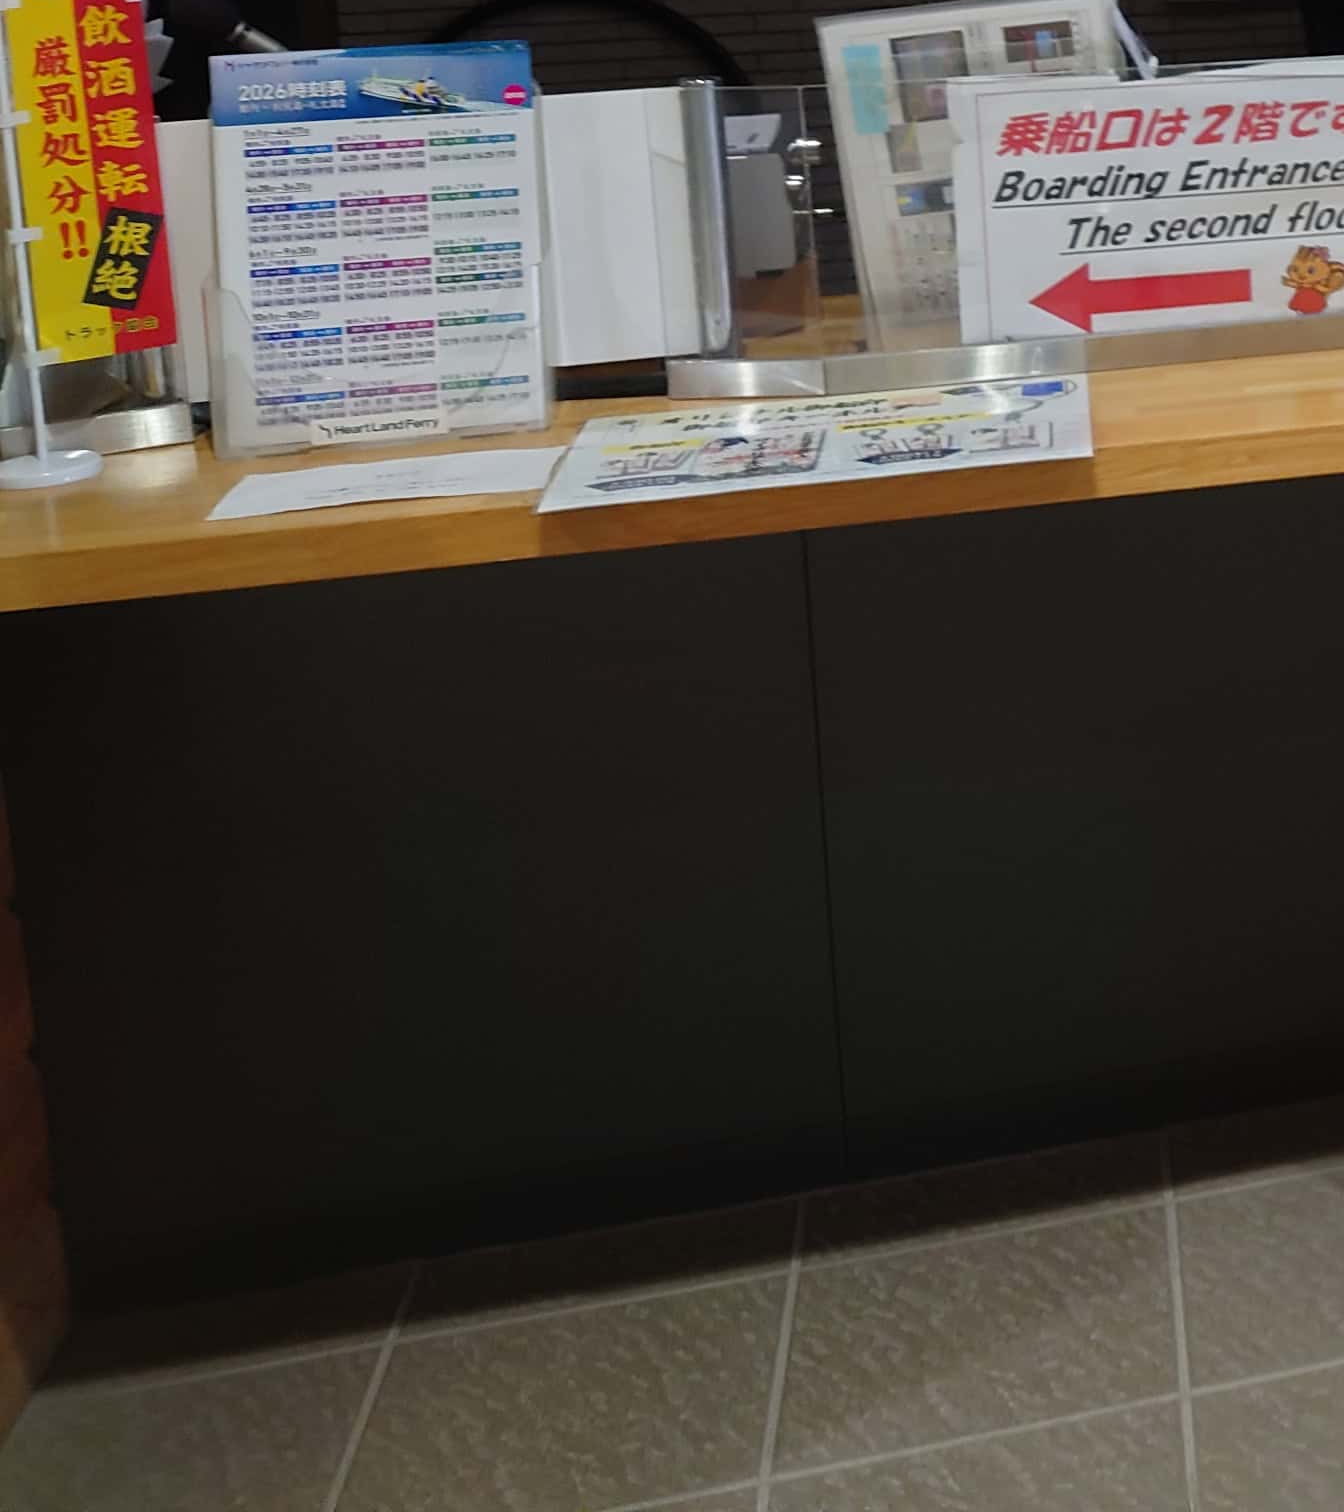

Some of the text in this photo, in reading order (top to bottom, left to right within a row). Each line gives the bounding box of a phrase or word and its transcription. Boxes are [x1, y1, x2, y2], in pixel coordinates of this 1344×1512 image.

[79, 3, 150, 204] 飲酒運転
[993, 164, 1170, 204] Boarding
[92, 214, 152, 302] 根絶
[1066, 218, 1132, 250] The
[1143, 203, 1278, 244] second
